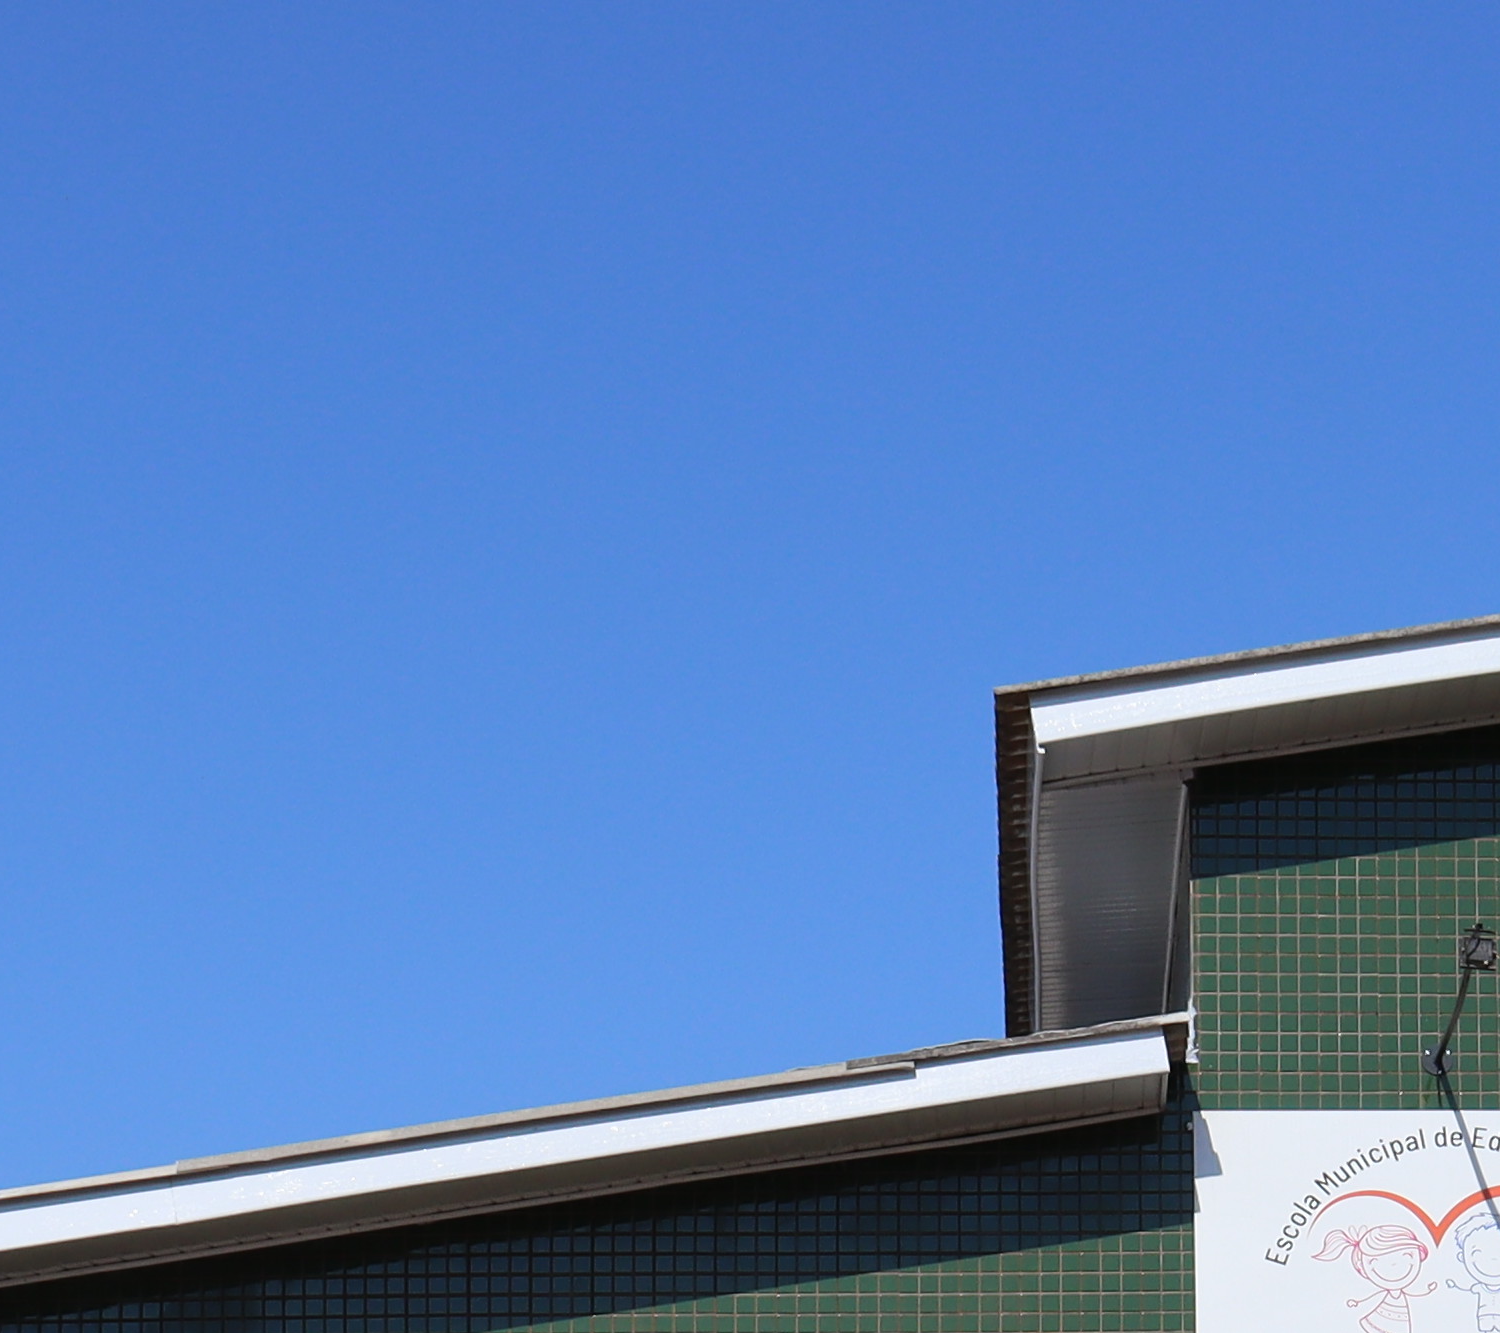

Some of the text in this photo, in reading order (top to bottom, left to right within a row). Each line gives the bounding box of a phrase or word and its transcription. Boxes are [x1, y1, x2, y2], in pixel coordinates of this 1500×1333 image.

[1265, 1194, 1321, 1268] Escola
[1314, 1128, 1427, 1197] Municipal
[1434, 1126, 1464, 1148] de
